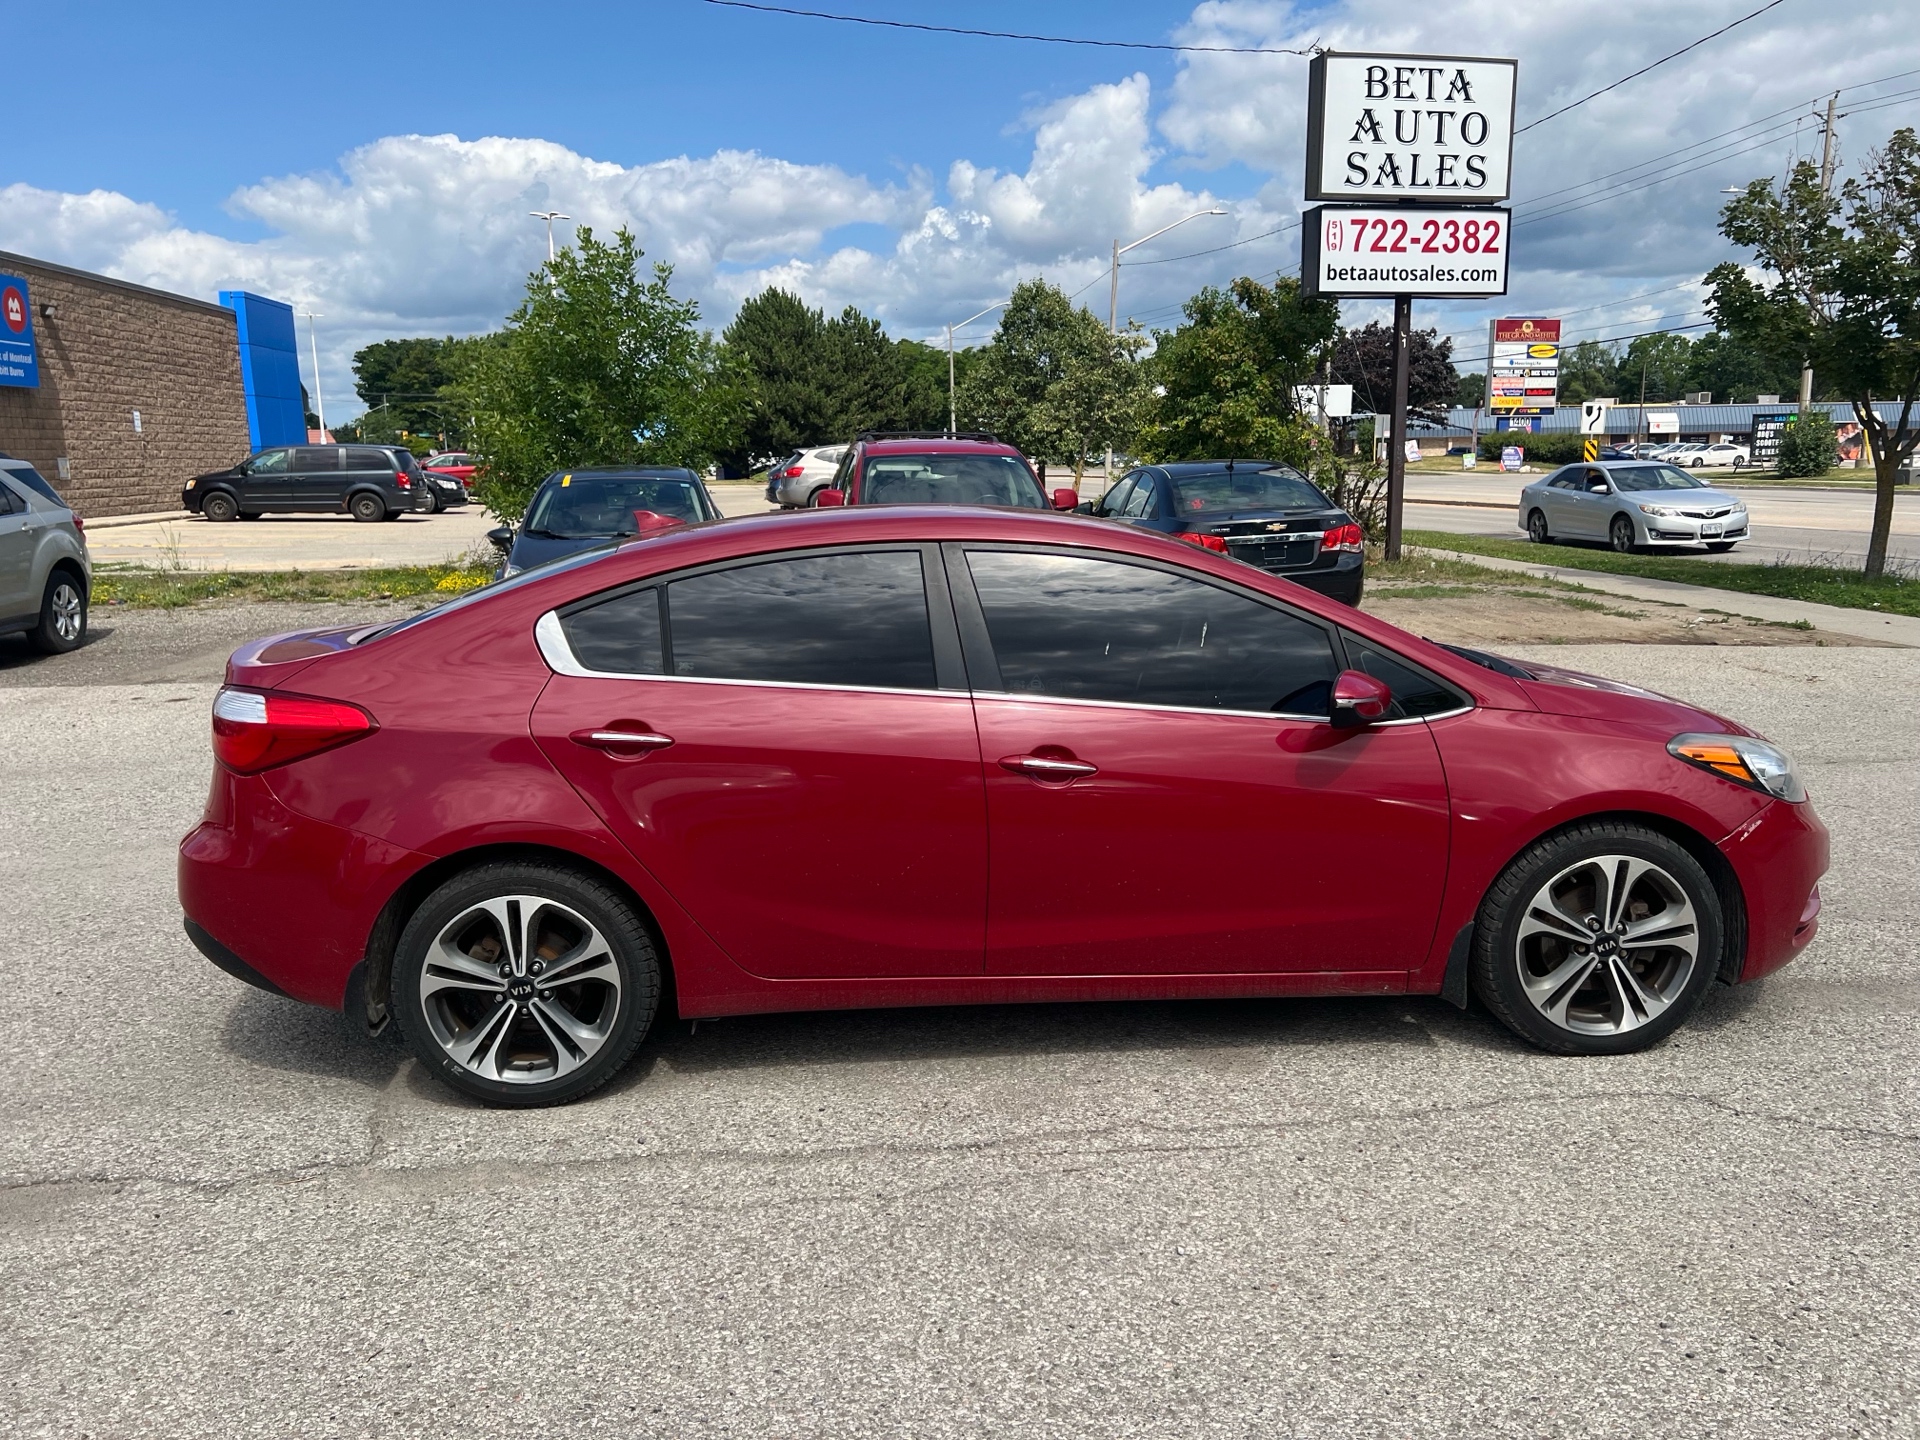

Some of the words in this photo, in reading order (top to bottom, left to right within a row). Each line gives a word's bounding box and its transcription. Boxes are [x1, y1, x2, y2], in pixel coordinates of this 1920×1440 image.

[1364, 65, 1476, 103] BETA
[1348, 108, 1491, 147] AUTO
[1344, 151, 1489, 190] SALES
[1350, 218, 1501, 254] 722-2382
[1326, 263, 1498, 282] betaautosales.com
[9, 352, 32, 364] Montreal
[1510, 417, 1530, 426] 1400
[1597, 941, 1616, 952] KIA
[511, 985, 531, 995] KIA
